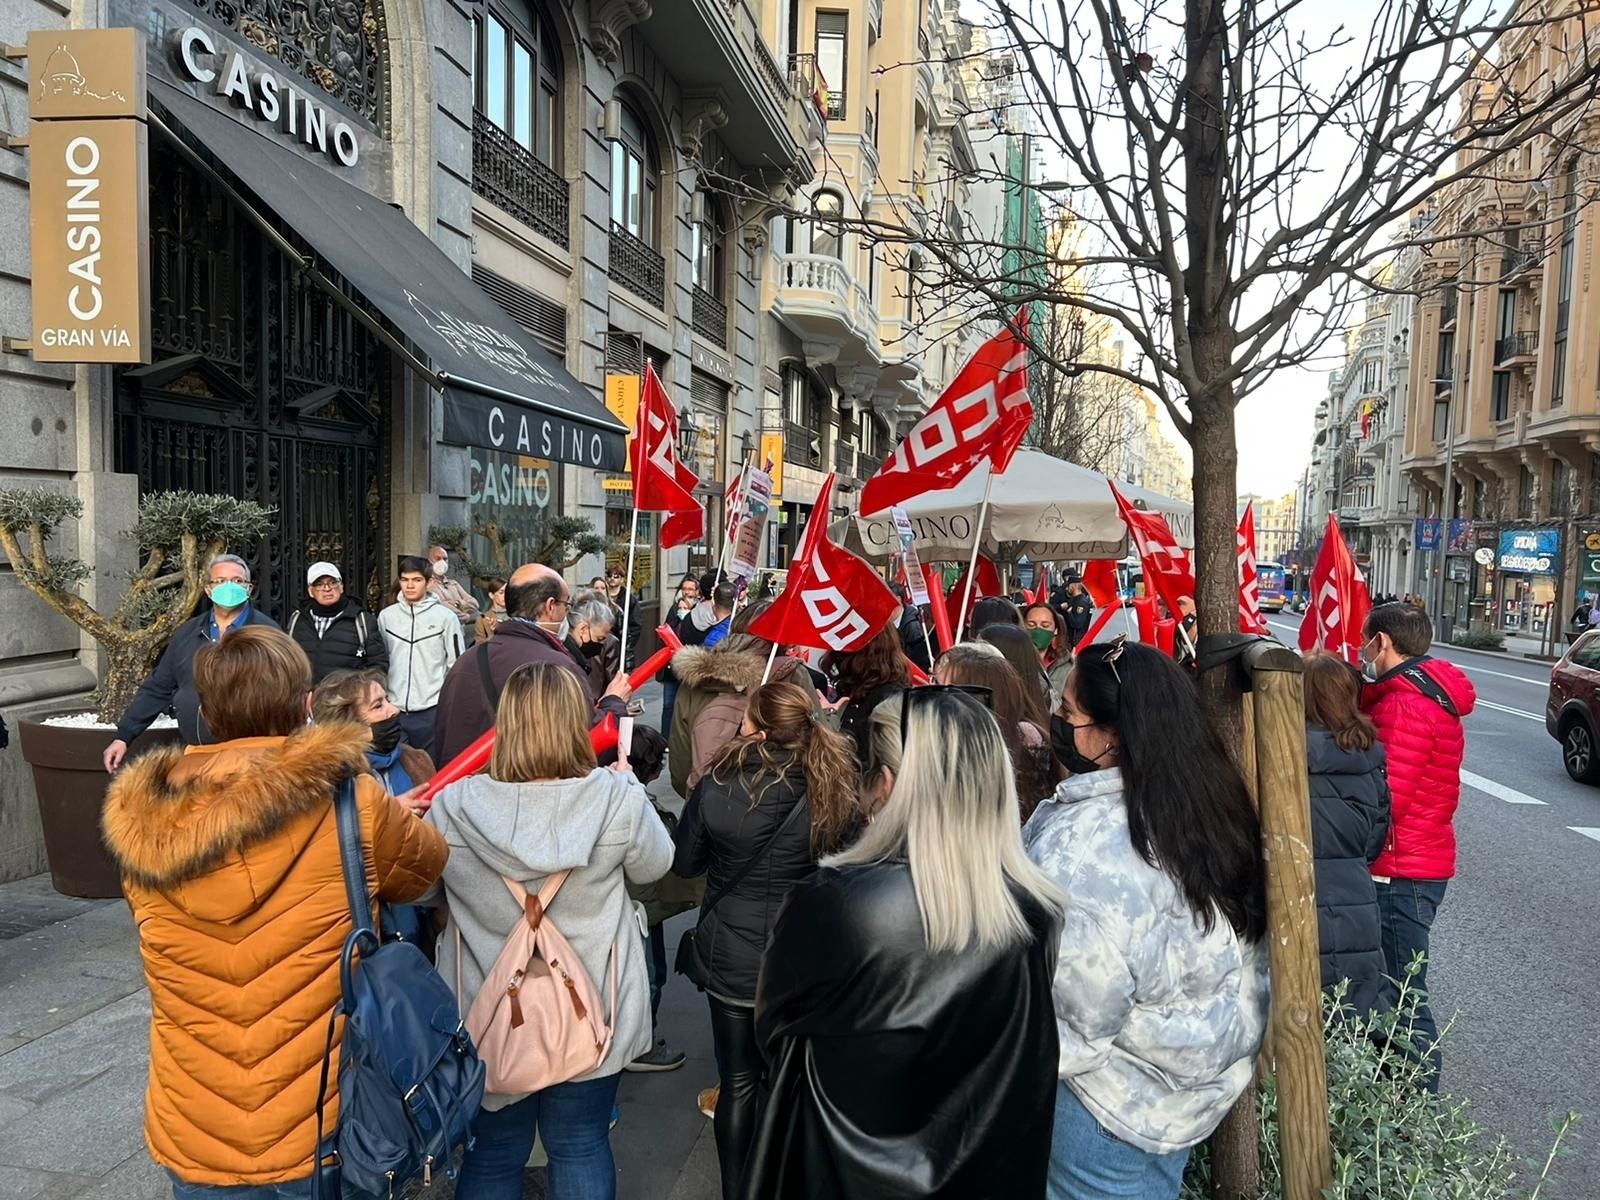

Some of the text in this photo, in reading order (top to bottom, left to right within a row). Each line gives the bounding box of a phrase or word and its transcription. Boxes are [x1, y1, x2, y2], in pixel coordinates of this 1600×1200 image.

[179, 26, 360, 168] CASINO
[65, 136, 103, 321] CASINO
[41, 323, 131, 347] GRAN VÍA
[488, 406, 602, 466] CASINO
[470, 458, 550, 508] CASINO
